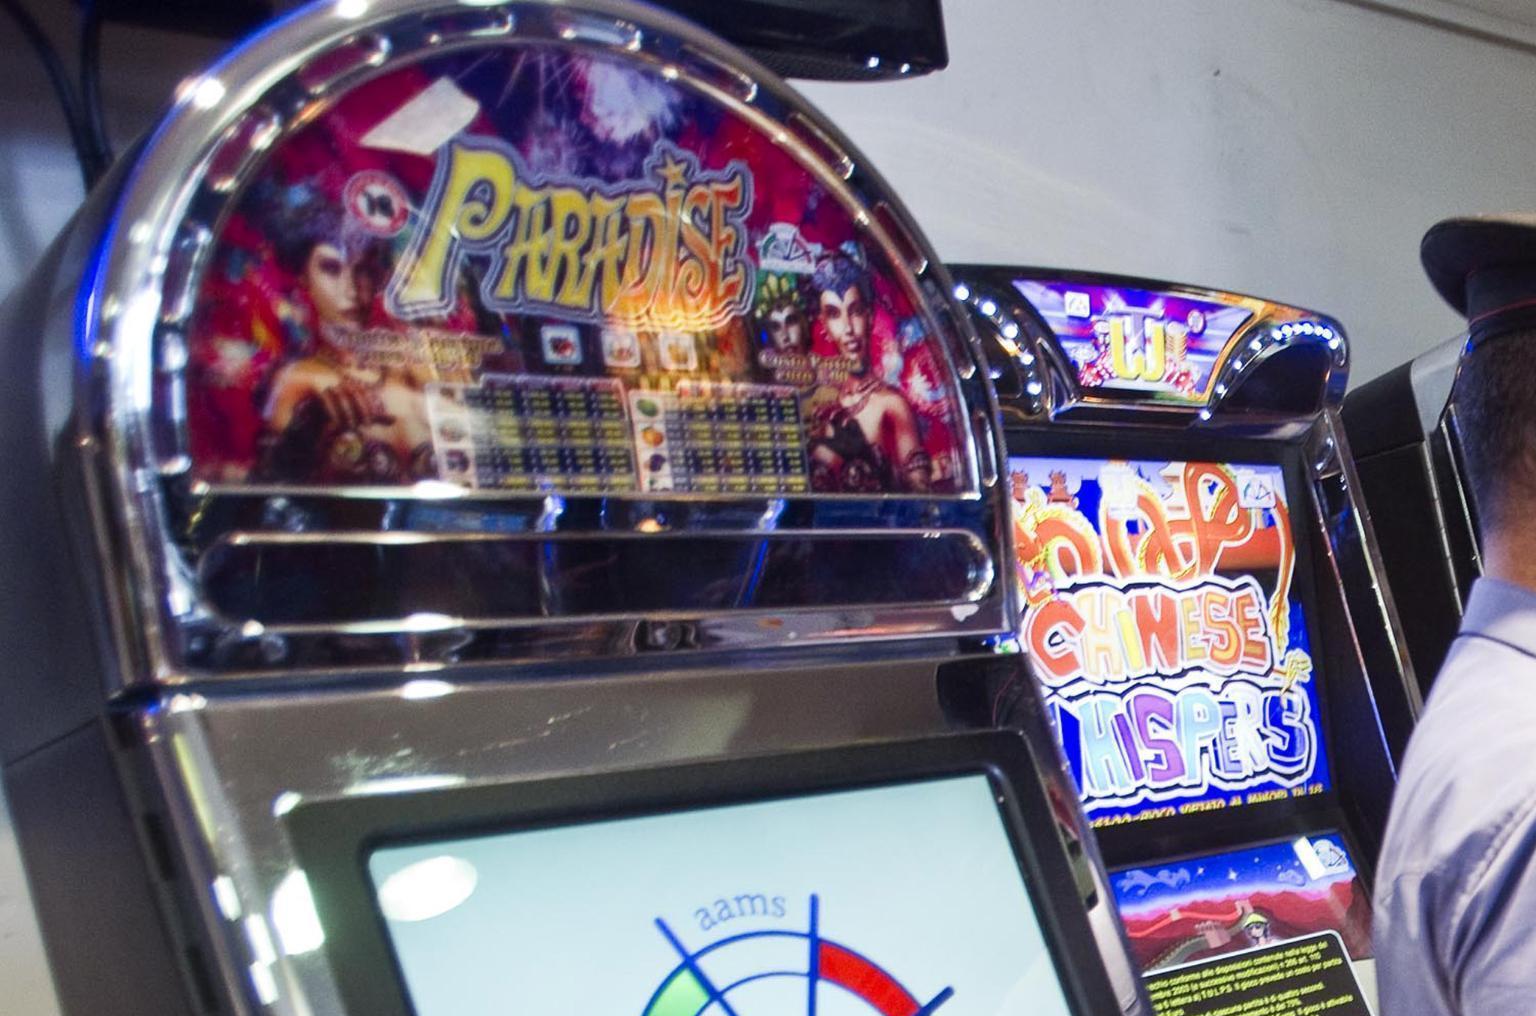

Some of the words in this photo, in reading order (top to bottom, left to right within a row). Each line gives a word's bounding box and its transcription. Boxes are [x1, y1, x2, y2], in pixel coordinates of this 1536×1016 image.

[391, 143, 750, 326] PARADISE
[1027, 590, 1269, 680] CHINESE
[693, 892, 787, 931] aams
